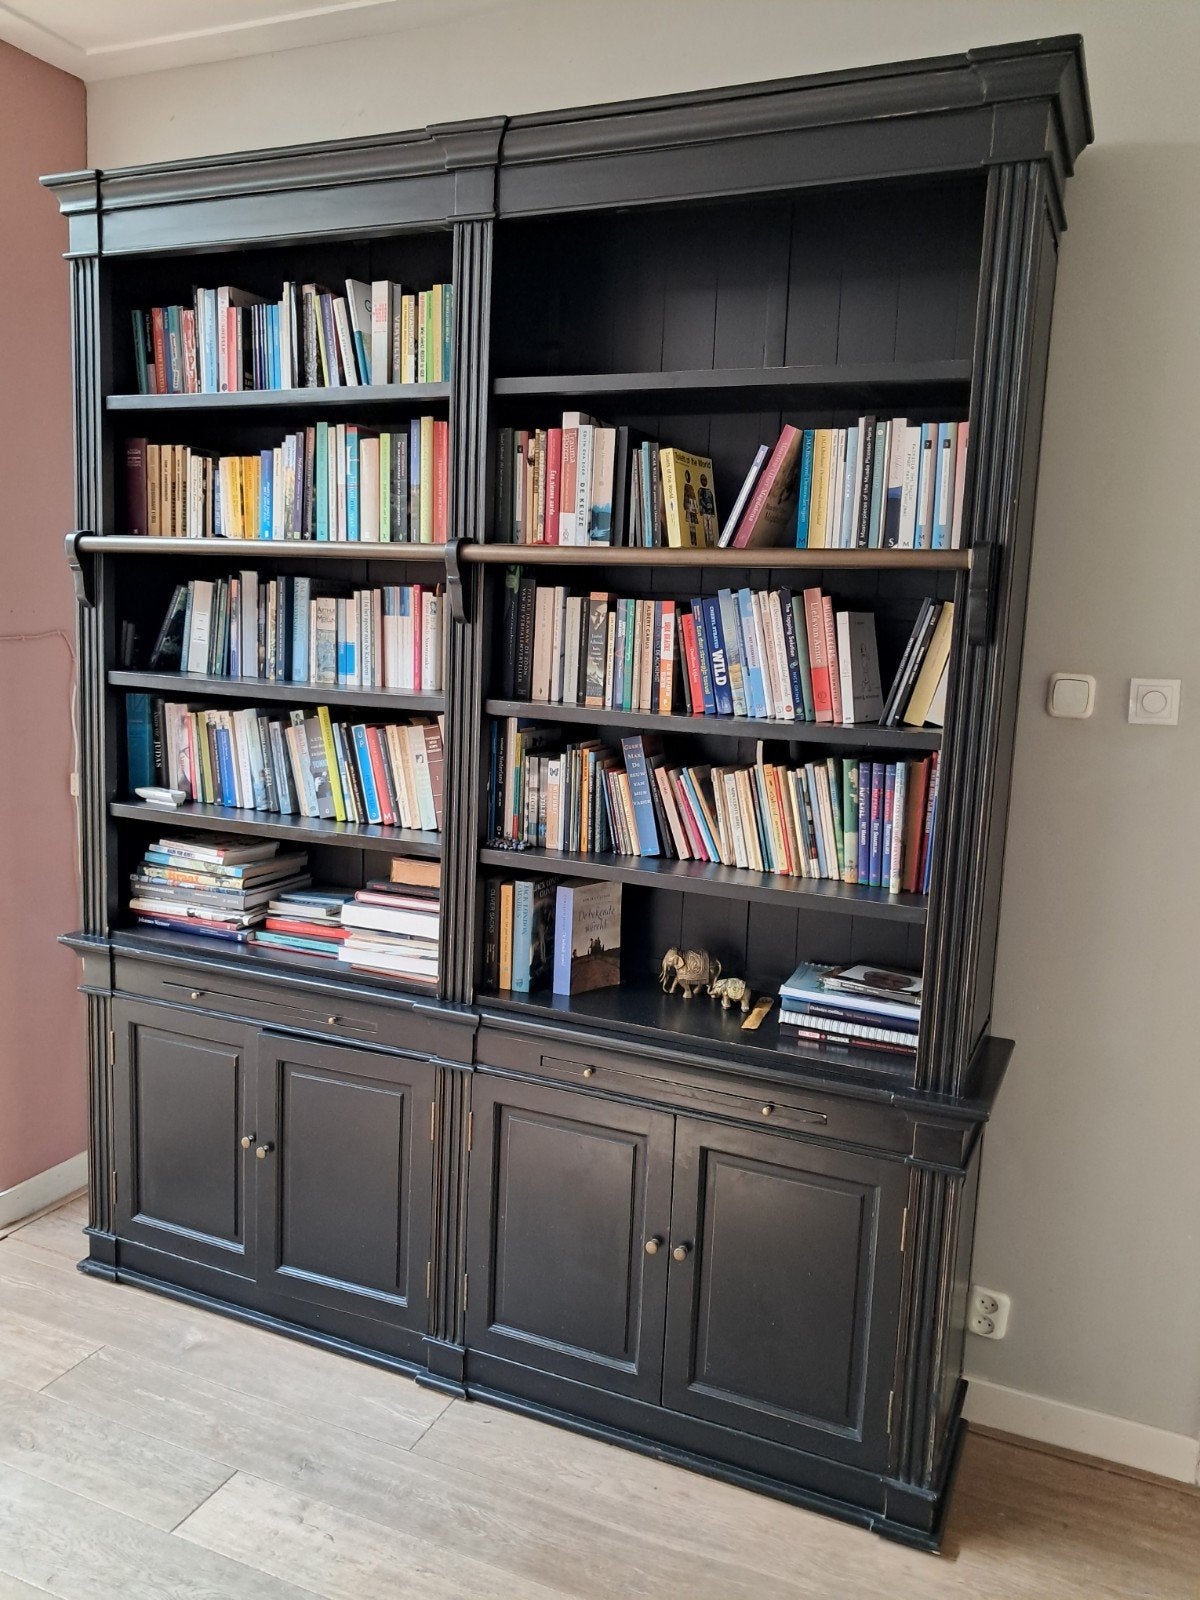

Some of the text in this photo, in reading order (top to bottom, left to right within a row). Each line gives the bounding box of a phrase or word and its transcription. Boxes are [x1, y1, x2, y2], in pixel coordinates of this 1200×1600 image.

[570, 430, 578, 464] Trauma
[698, 459, 711, 469] World
[580, 482, 586, 494] DE
[578, 498, 586, 528] KEUZE
[748, 490, 768, 522] Magdalena
[521, 604, 526, 612] DE
[810, 602, 820, 624] Liefs
[823, 604, 832, 620] MIDAS
[786, 614, 794, 635] Tapping
[524, 646, 530, 654] DE
[788, 636, 796, 658] Solution
[814, 638, 822, 664] Annie
[712, 649, 727, 686] WILD
[154, 741, 162, 768] JUDAS
[810, 1005, 828, 1014] Diabetes
